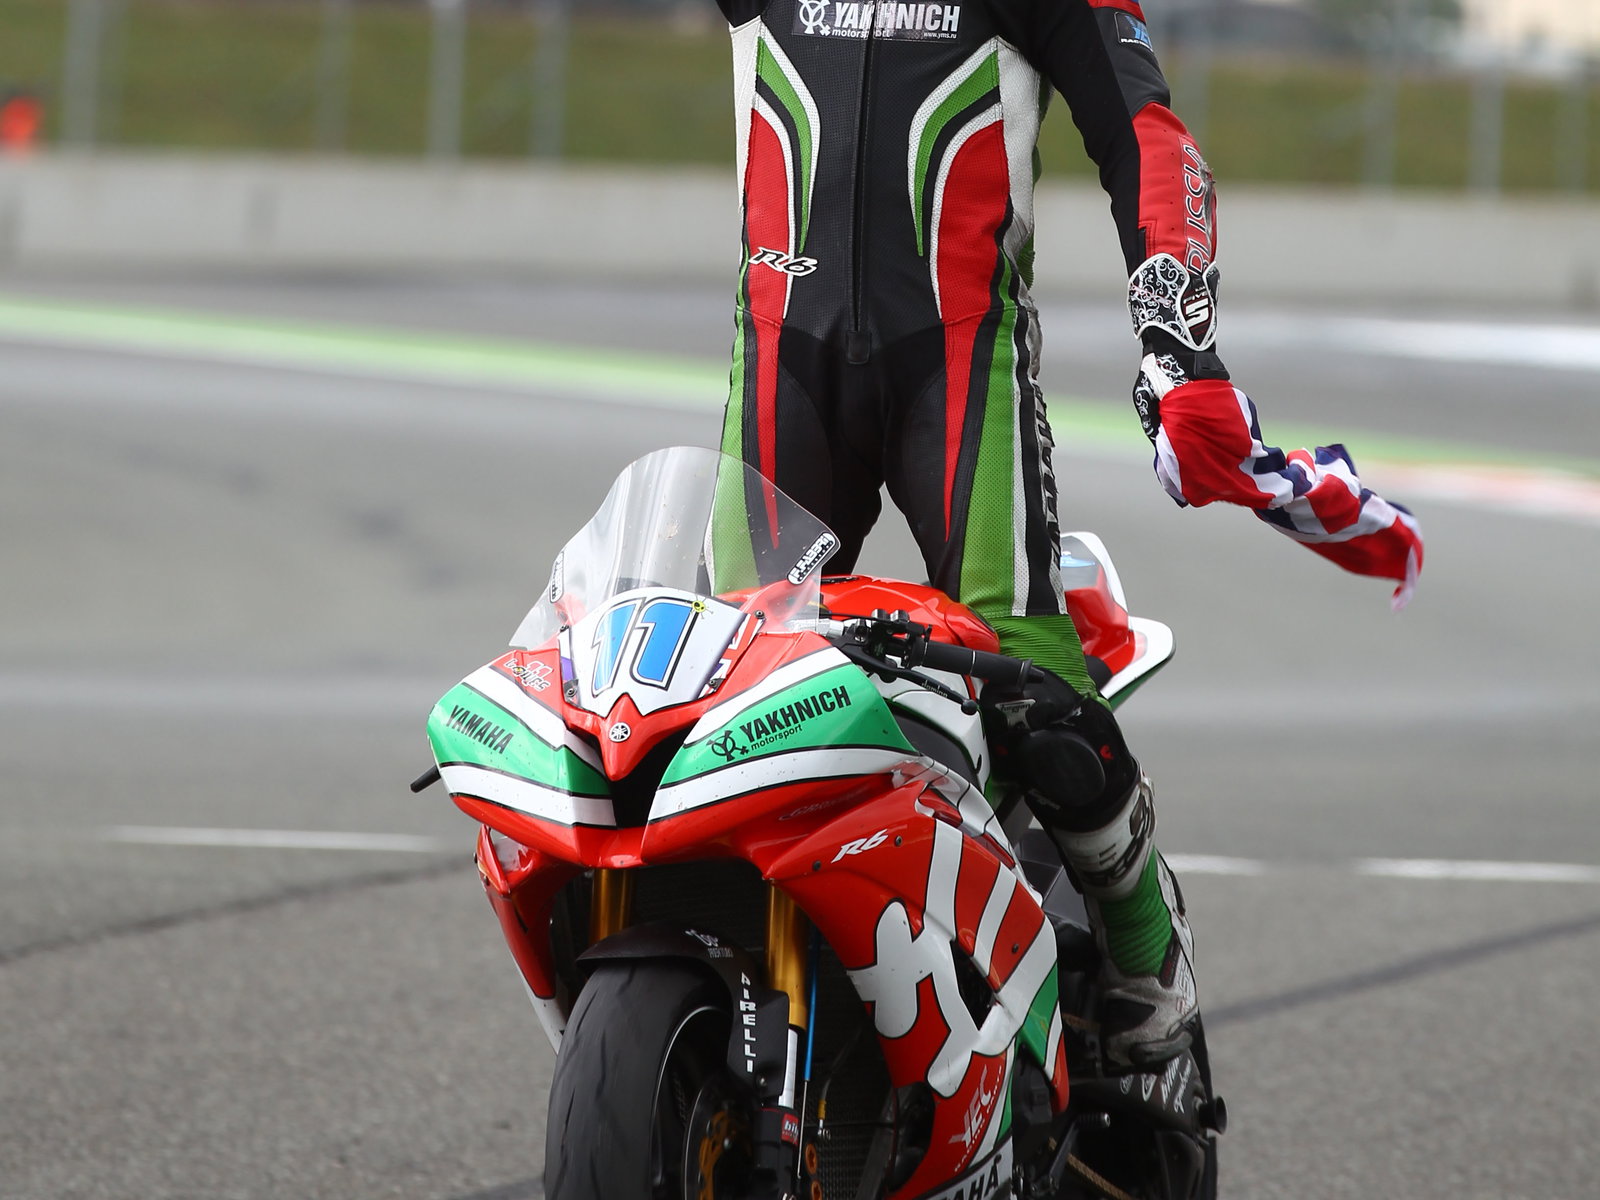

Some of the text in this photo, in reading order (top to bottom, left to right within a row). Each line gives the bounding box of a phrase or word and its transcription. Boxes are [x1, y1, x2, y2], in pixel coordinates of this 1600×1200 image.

[834, 1, 961, 32] YAKHNICH
[748, 246, 819, 276] R6
[591, 596, 700, 698] 11
[445, 704, 515, 755] YAMAHA
[740, 685, 852, 742] YAKHNICH
[750, 723, 803, 753] motorsport
[831, 828, 889, 864] R6
